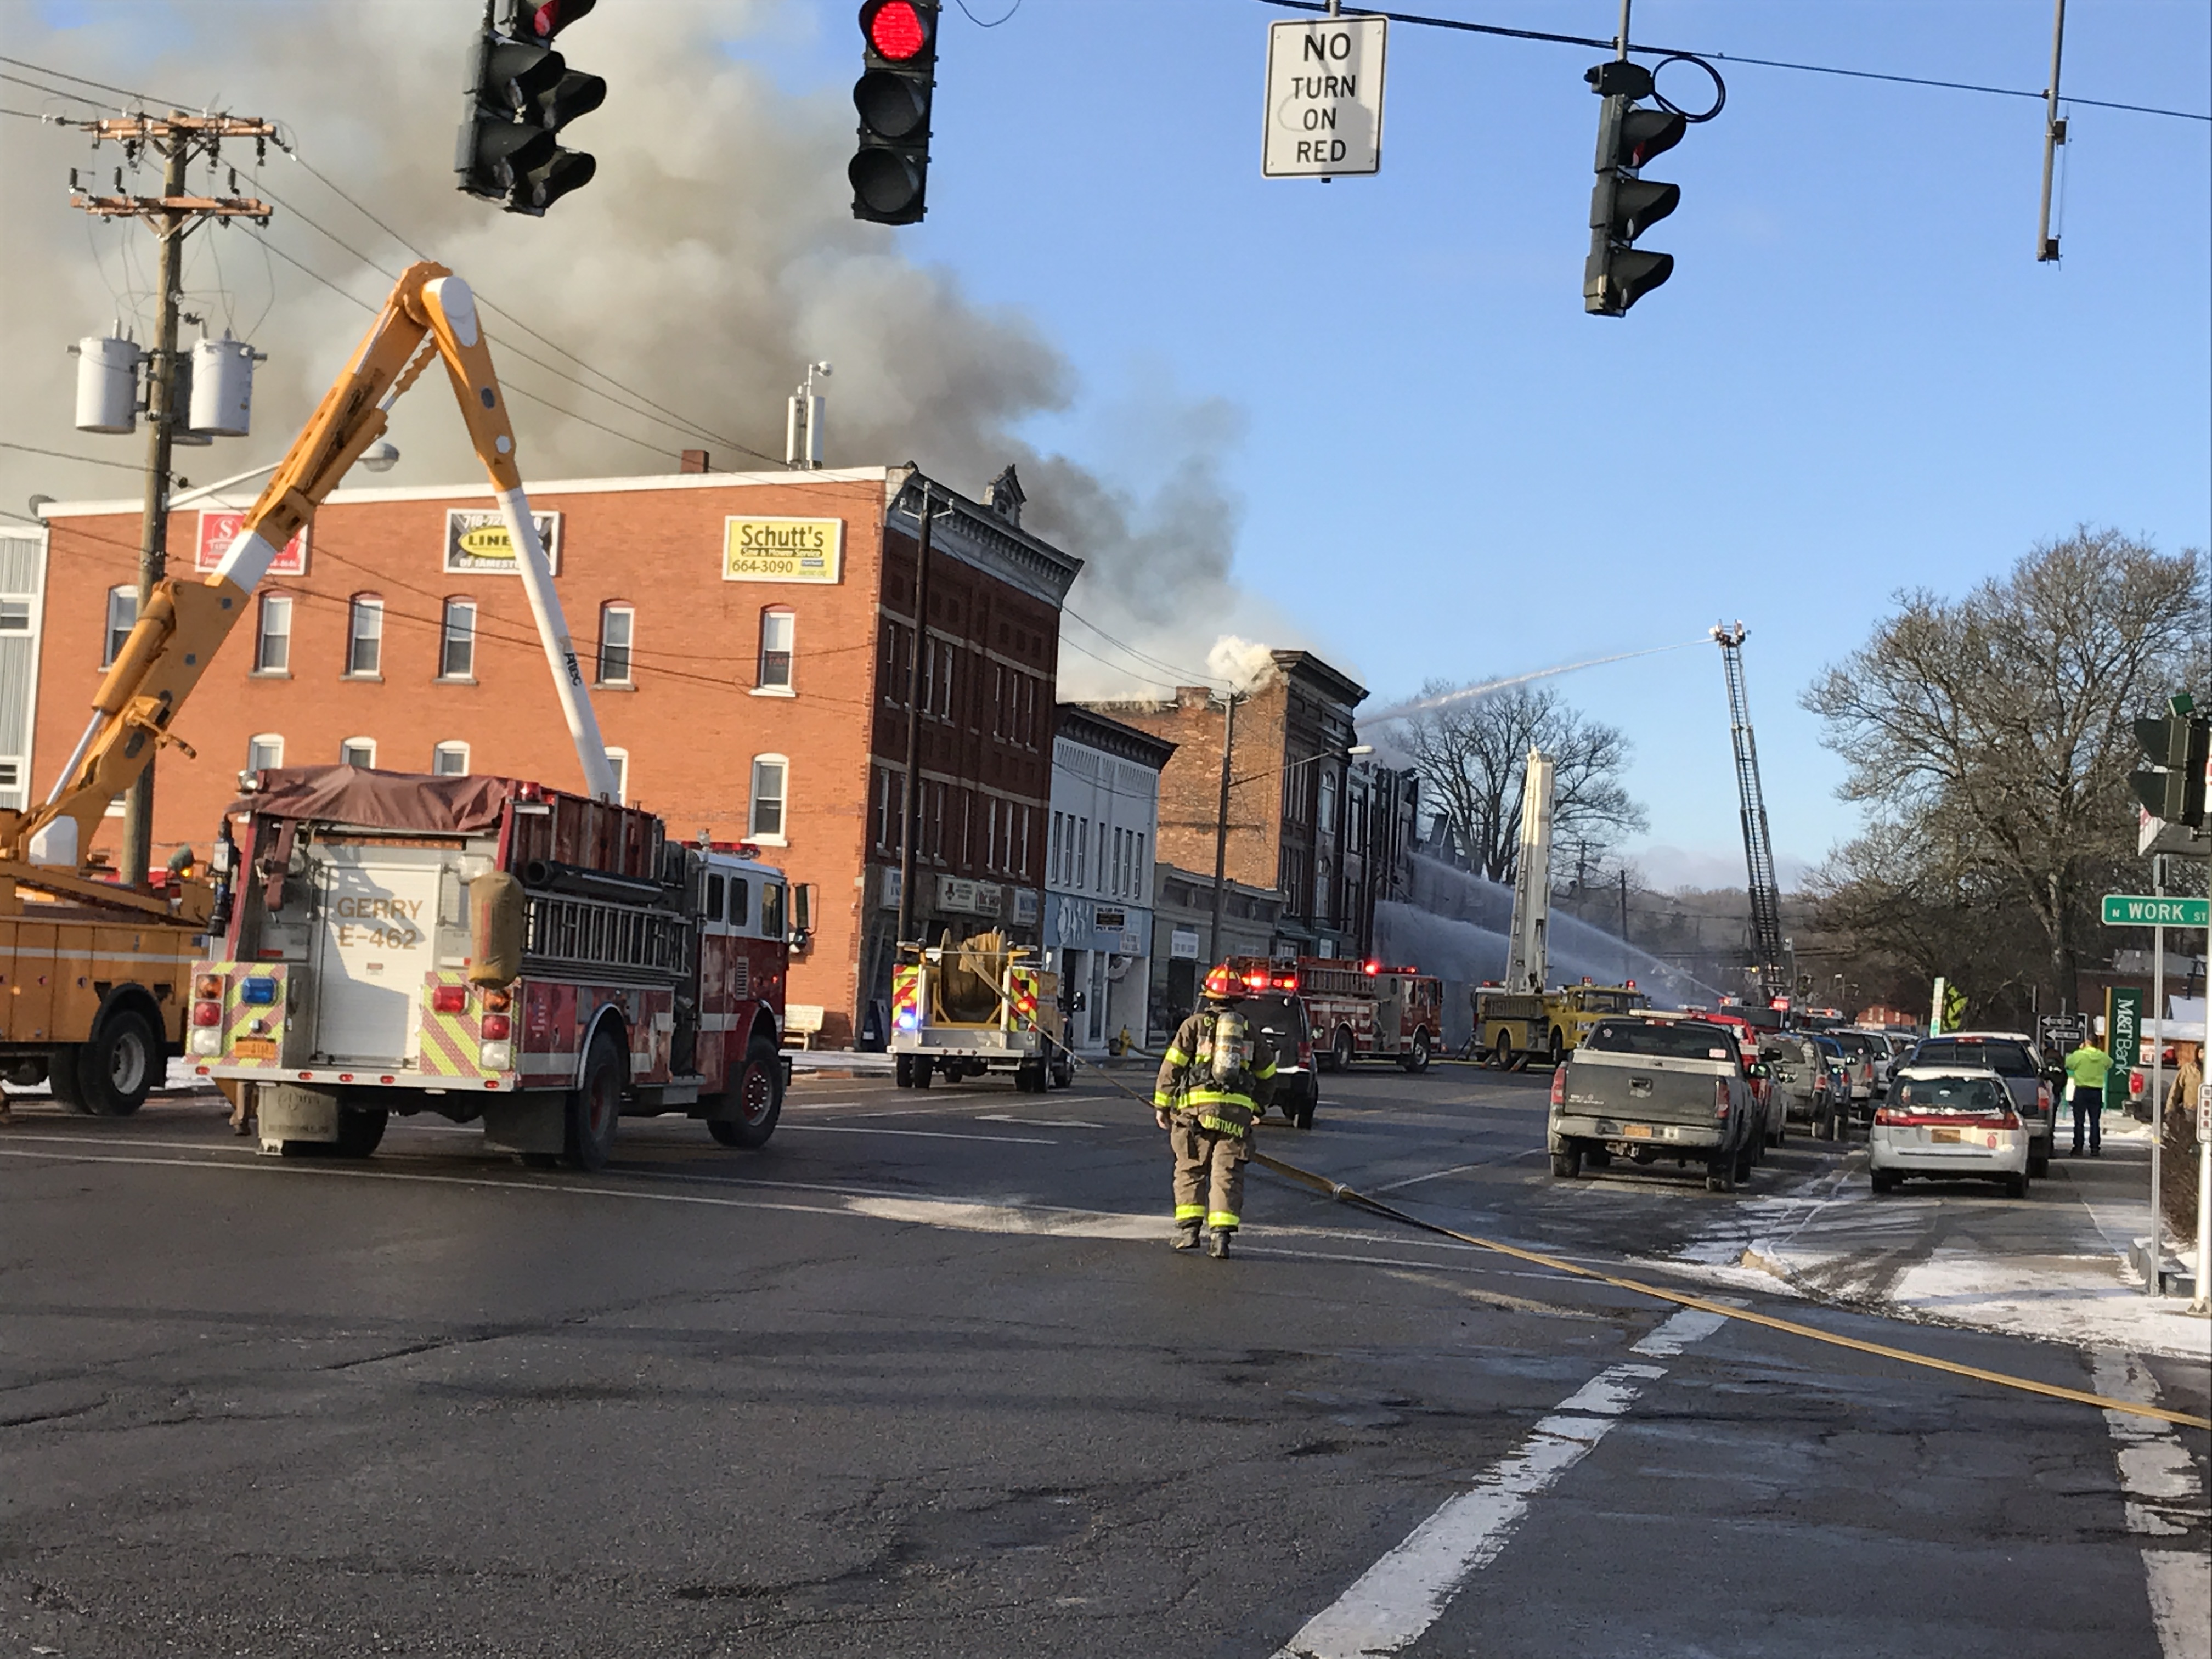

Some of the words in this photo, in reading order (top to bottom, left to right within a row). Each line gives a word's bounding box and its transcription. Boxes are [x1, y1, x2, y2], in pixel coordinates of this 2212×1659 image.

[1304, 32, 1351, 61] NO
[1291, 75, 1356, 99] TURN
[1303, 108, 1337, 131] ON
[1296, 139, 1346, 163] RED
[741, 524, 823, 547] Schutt's
[732, 559, 793, 573] 664-3090
[337, 896, 424, 920] GERRY
[2112, 909, 2120, 917] N
[2128, 902, 2185, 921] WORK
[2193, 911, 2207, 922] ST
[339, 926, 417, 950] E-462
[2115, 1038, 2132, 1075] Bank
